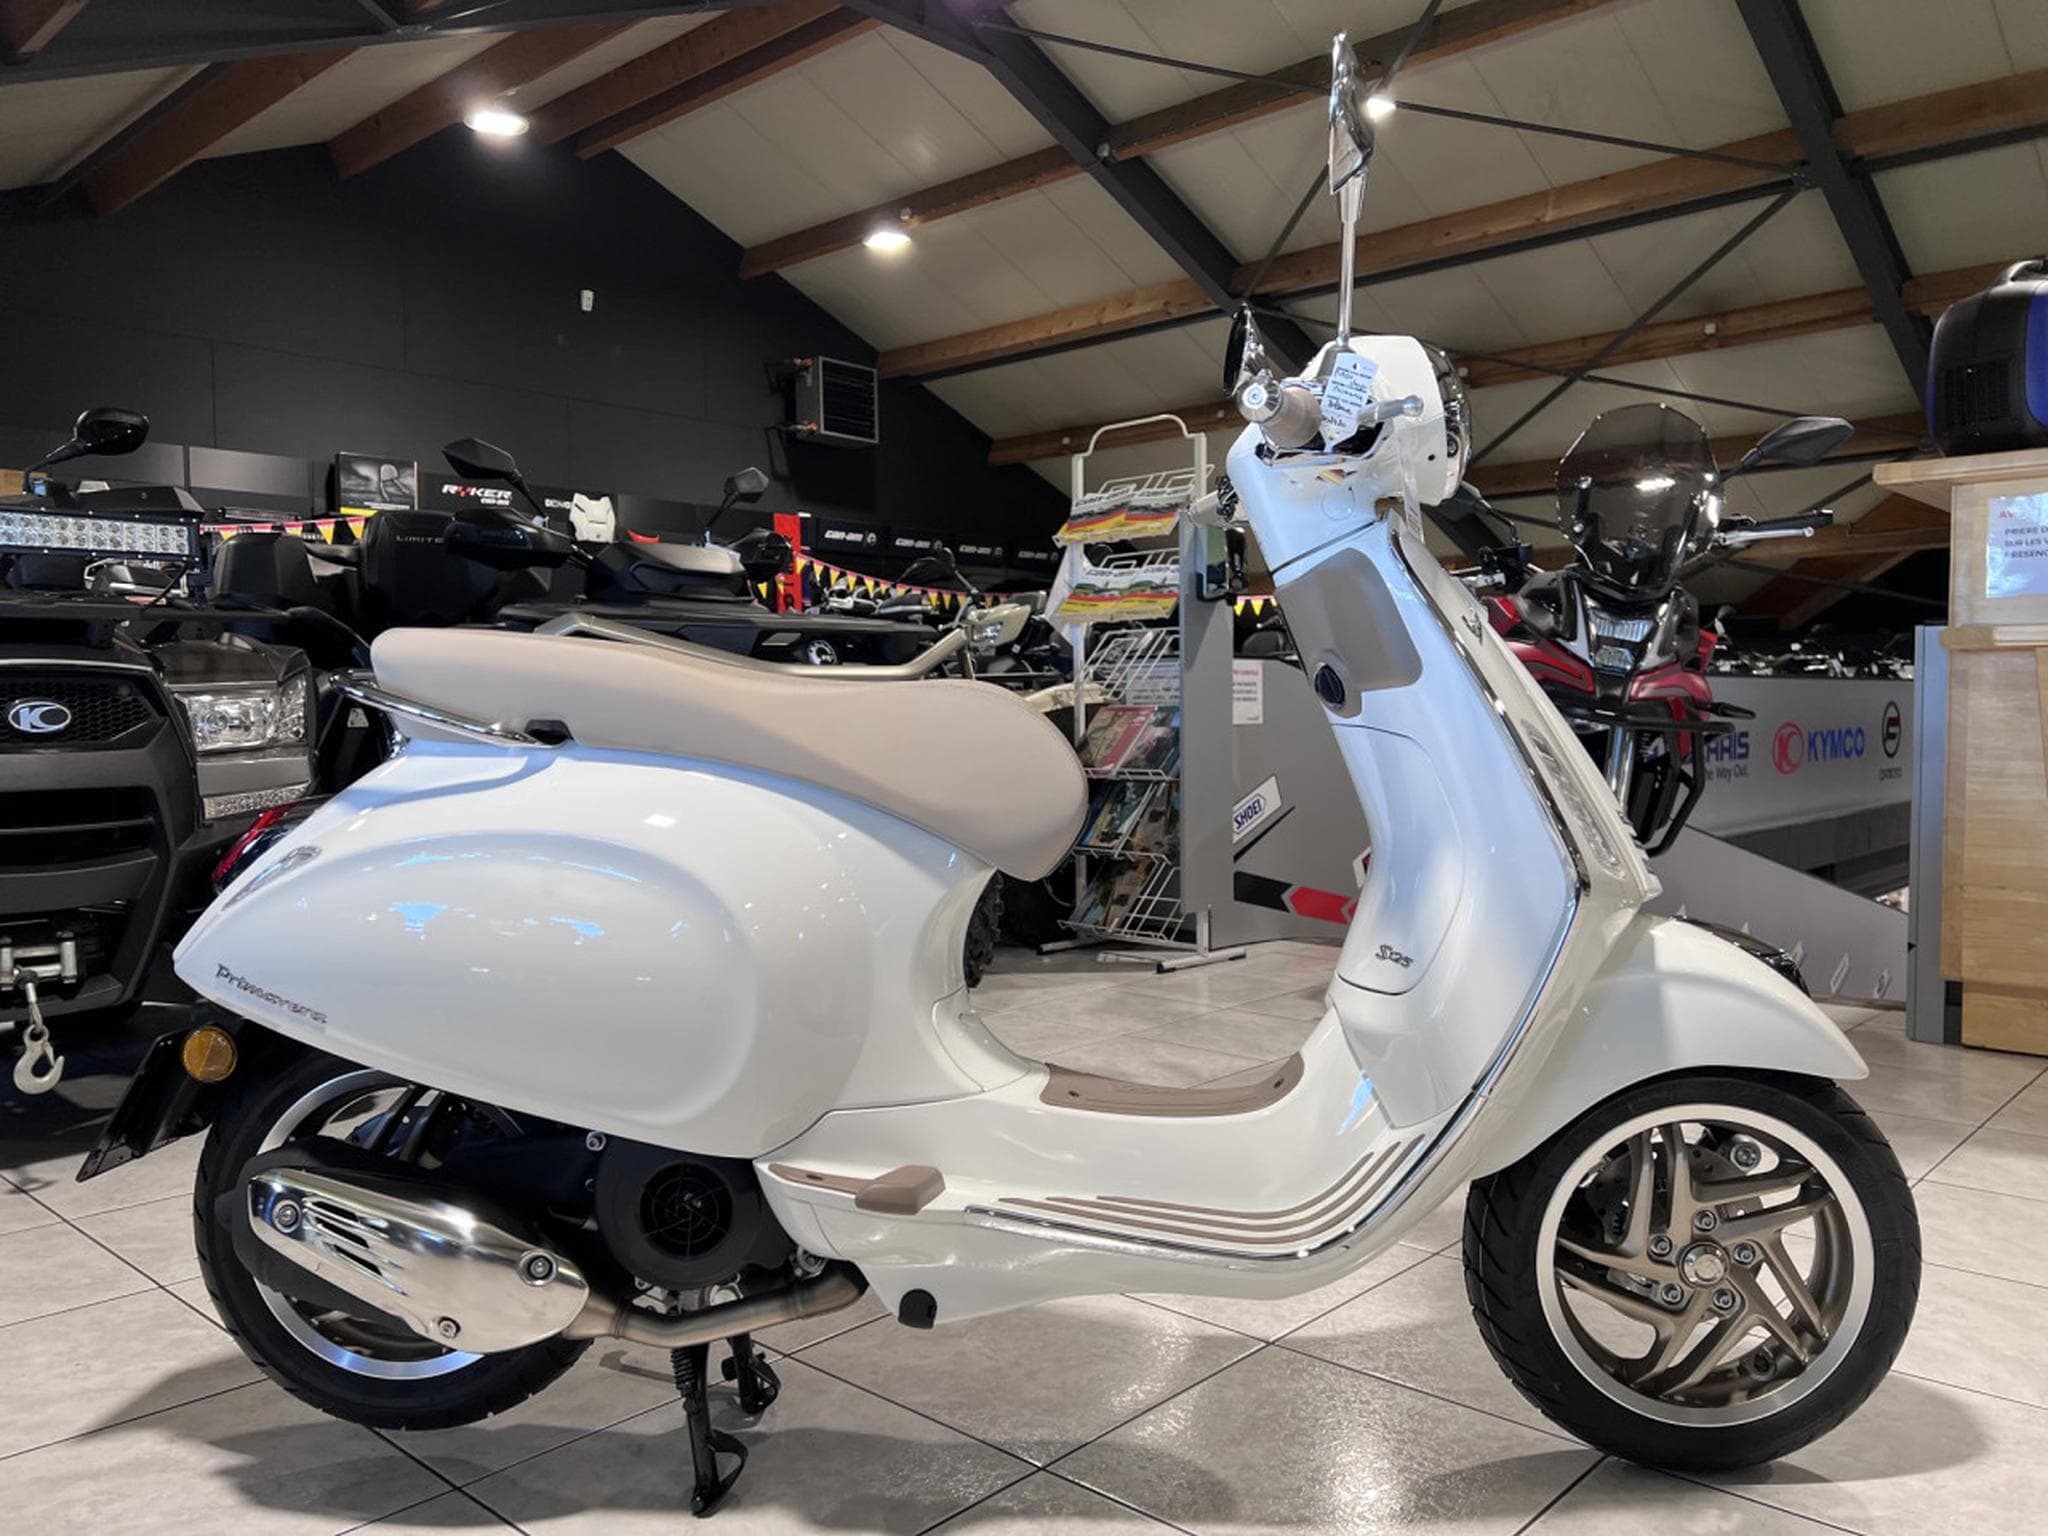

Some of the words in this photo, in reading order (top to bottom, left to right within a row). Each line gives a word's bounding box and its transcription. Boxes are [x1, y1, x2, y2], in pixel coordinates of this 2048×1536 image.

[442, 484, 512, 500] RYKER
[396, 535, 446, 544] LIMITE
[1808, 727, 1866, 761] KYMCO
[1234, 798, 1262, 830] SHOEI
[216, 963, 328, 1024] Primavera
